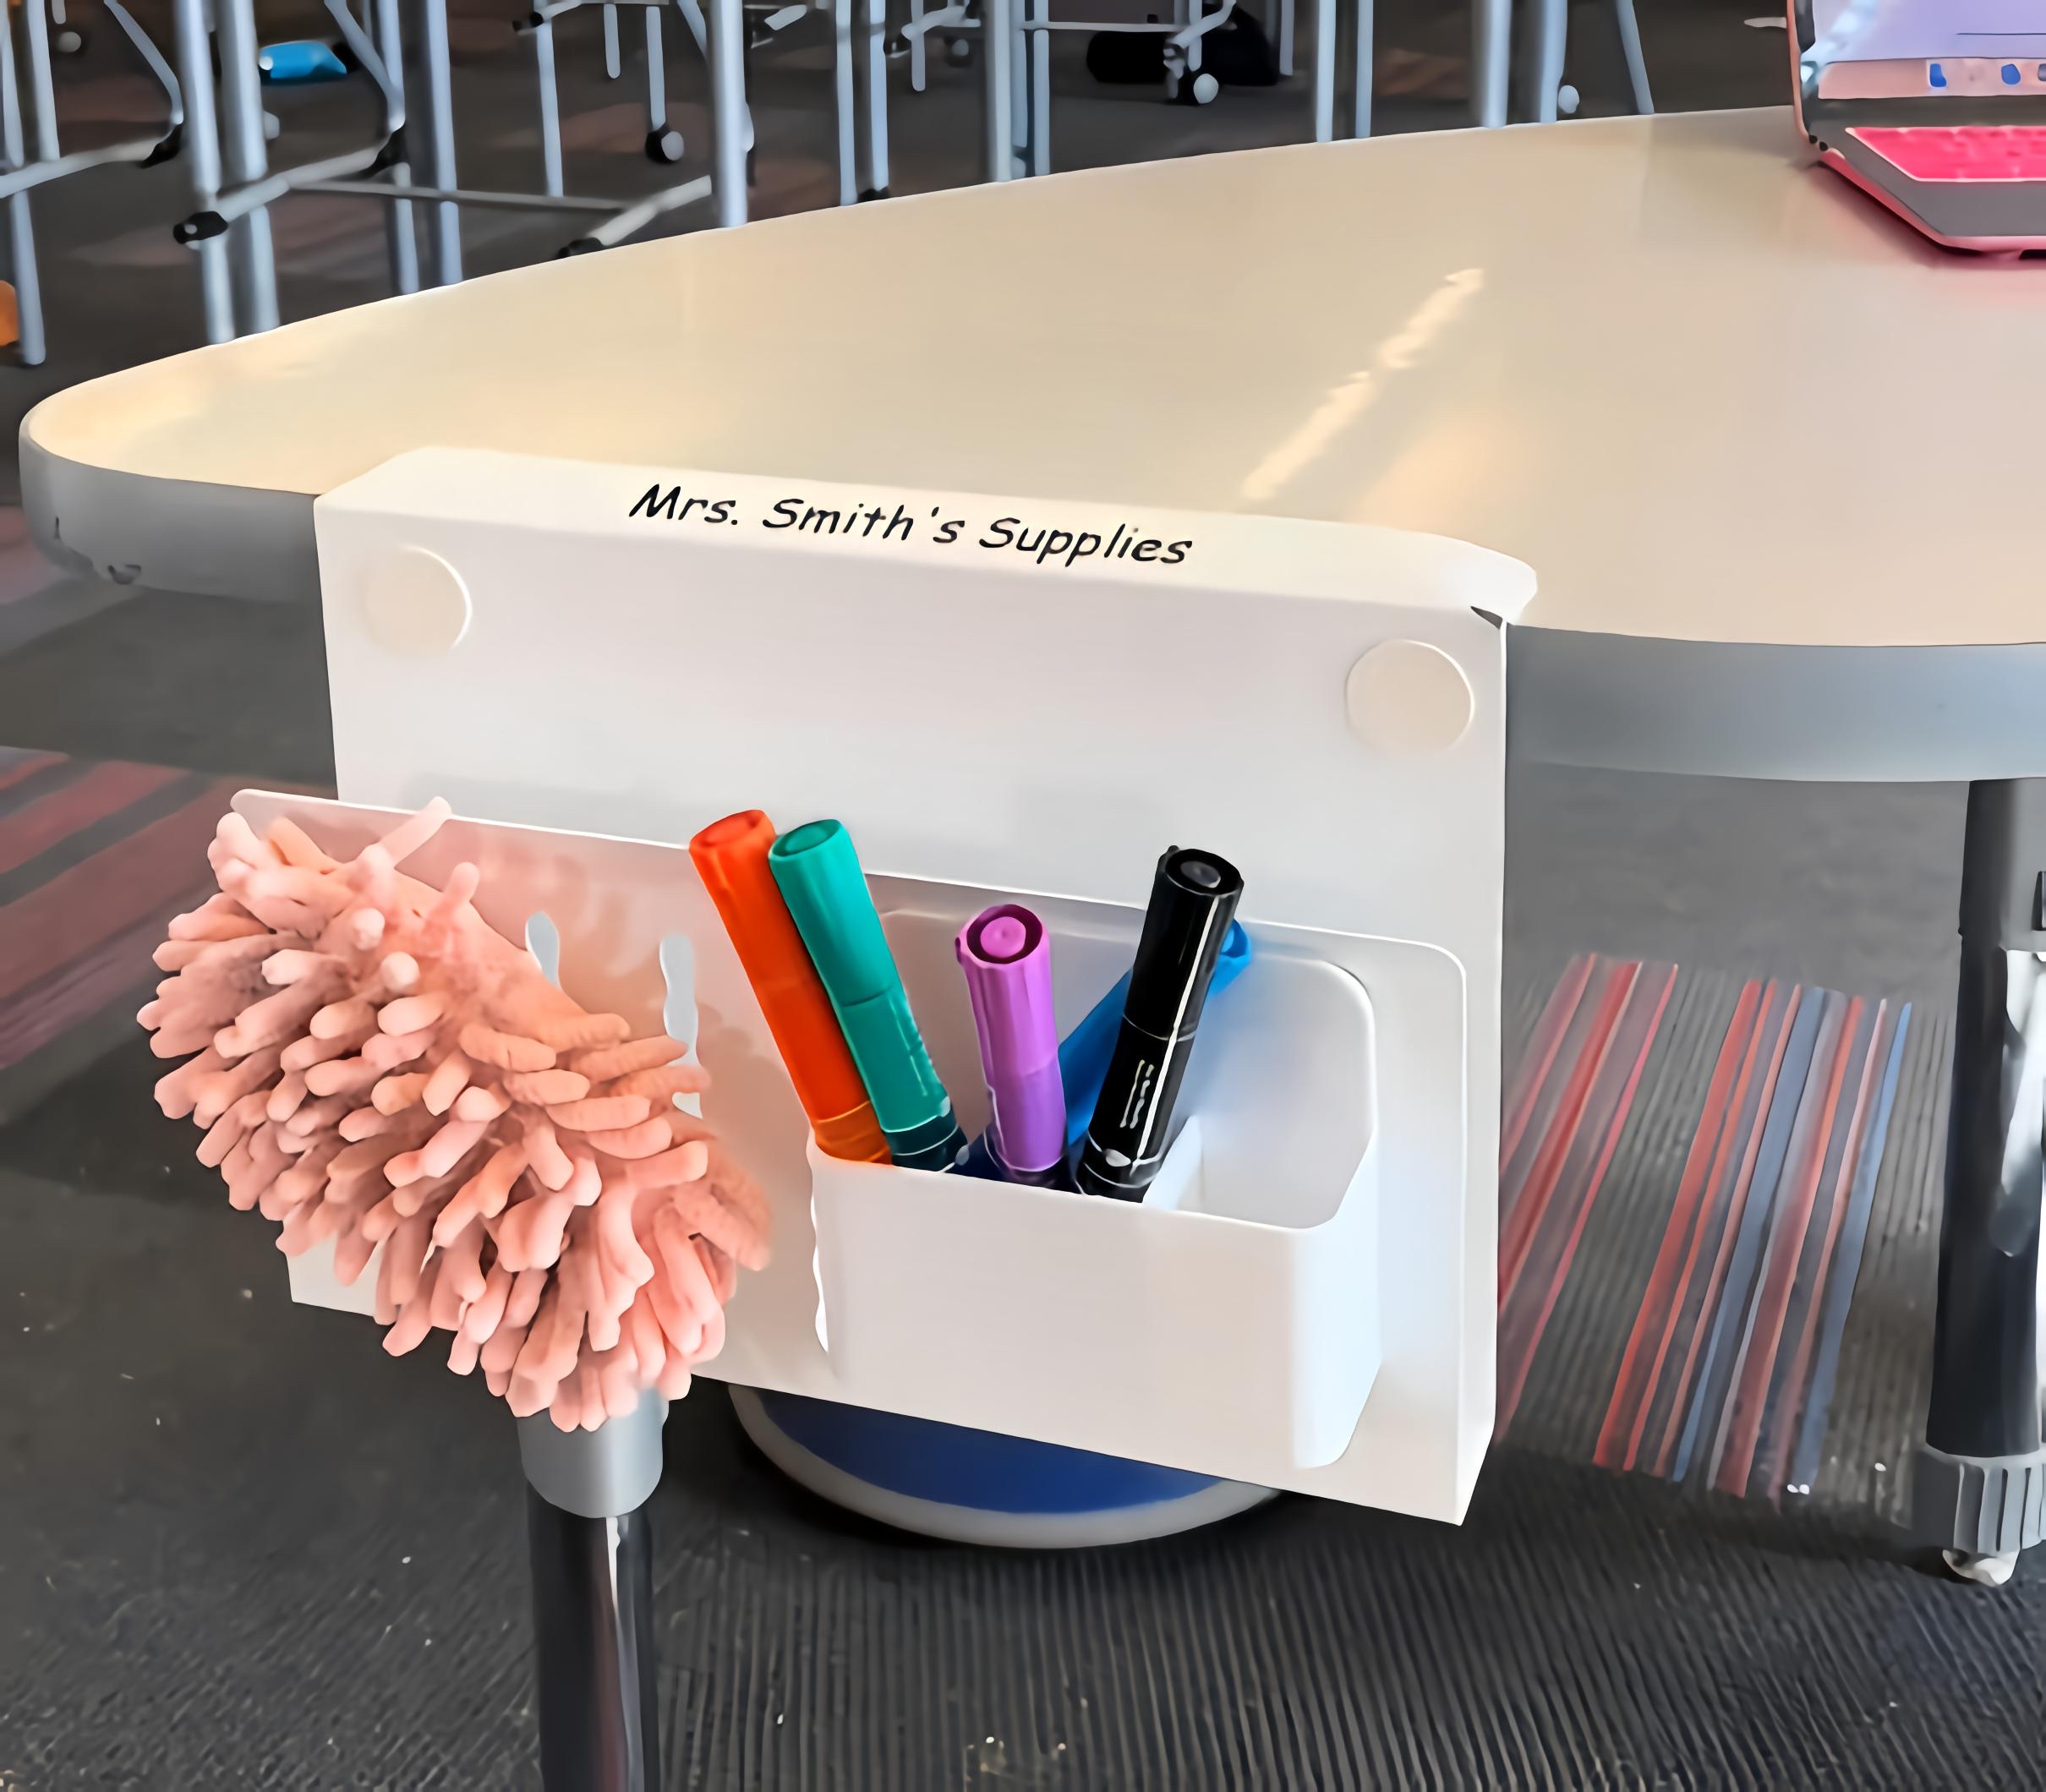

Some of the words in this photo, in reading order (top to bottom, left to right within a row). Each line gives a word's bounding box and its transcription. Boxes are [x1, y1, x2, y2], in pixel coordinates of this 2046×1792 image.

[628, 484, 738, 526] Mrs.
[762, 498, 966, 544] Smith's
[978, 517, 1193, 567] Supplies
